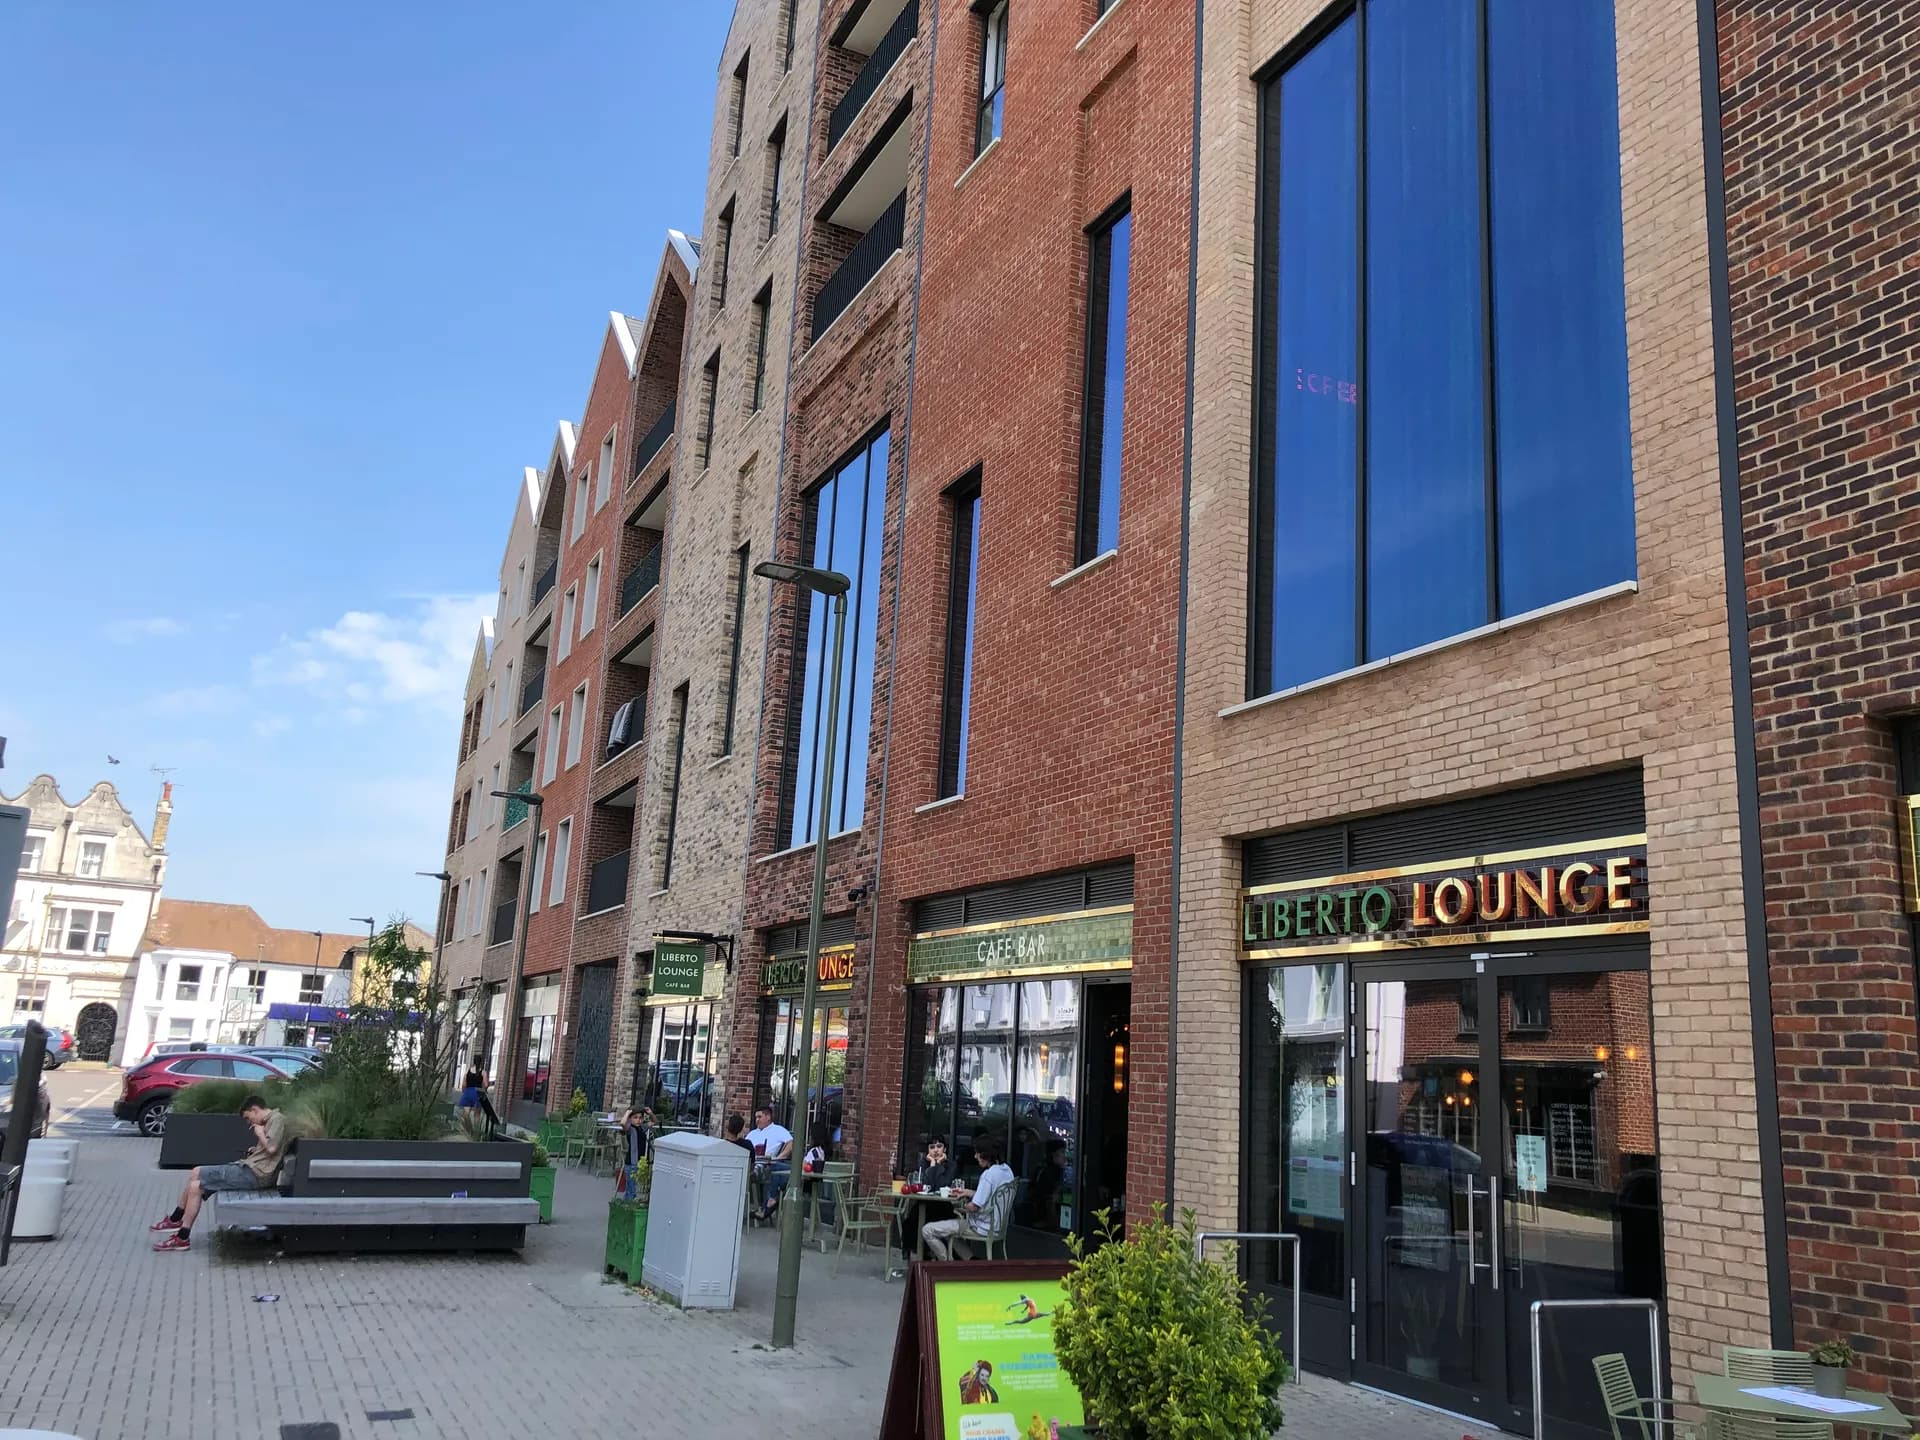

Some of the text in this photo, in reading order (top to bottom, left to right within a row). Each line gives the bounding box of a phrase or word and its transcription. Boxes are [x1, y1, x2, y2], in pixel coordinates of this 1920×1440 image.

[1244, 857, 1641, 941] LIBERTO LOUNGE
[661, 952, 698, 963] LIBERTO
[1018, 934, 1045, 958] BAR
[658, 966, 699, 977] LOUNGE
[816, 952, 855, 981] UNGE
